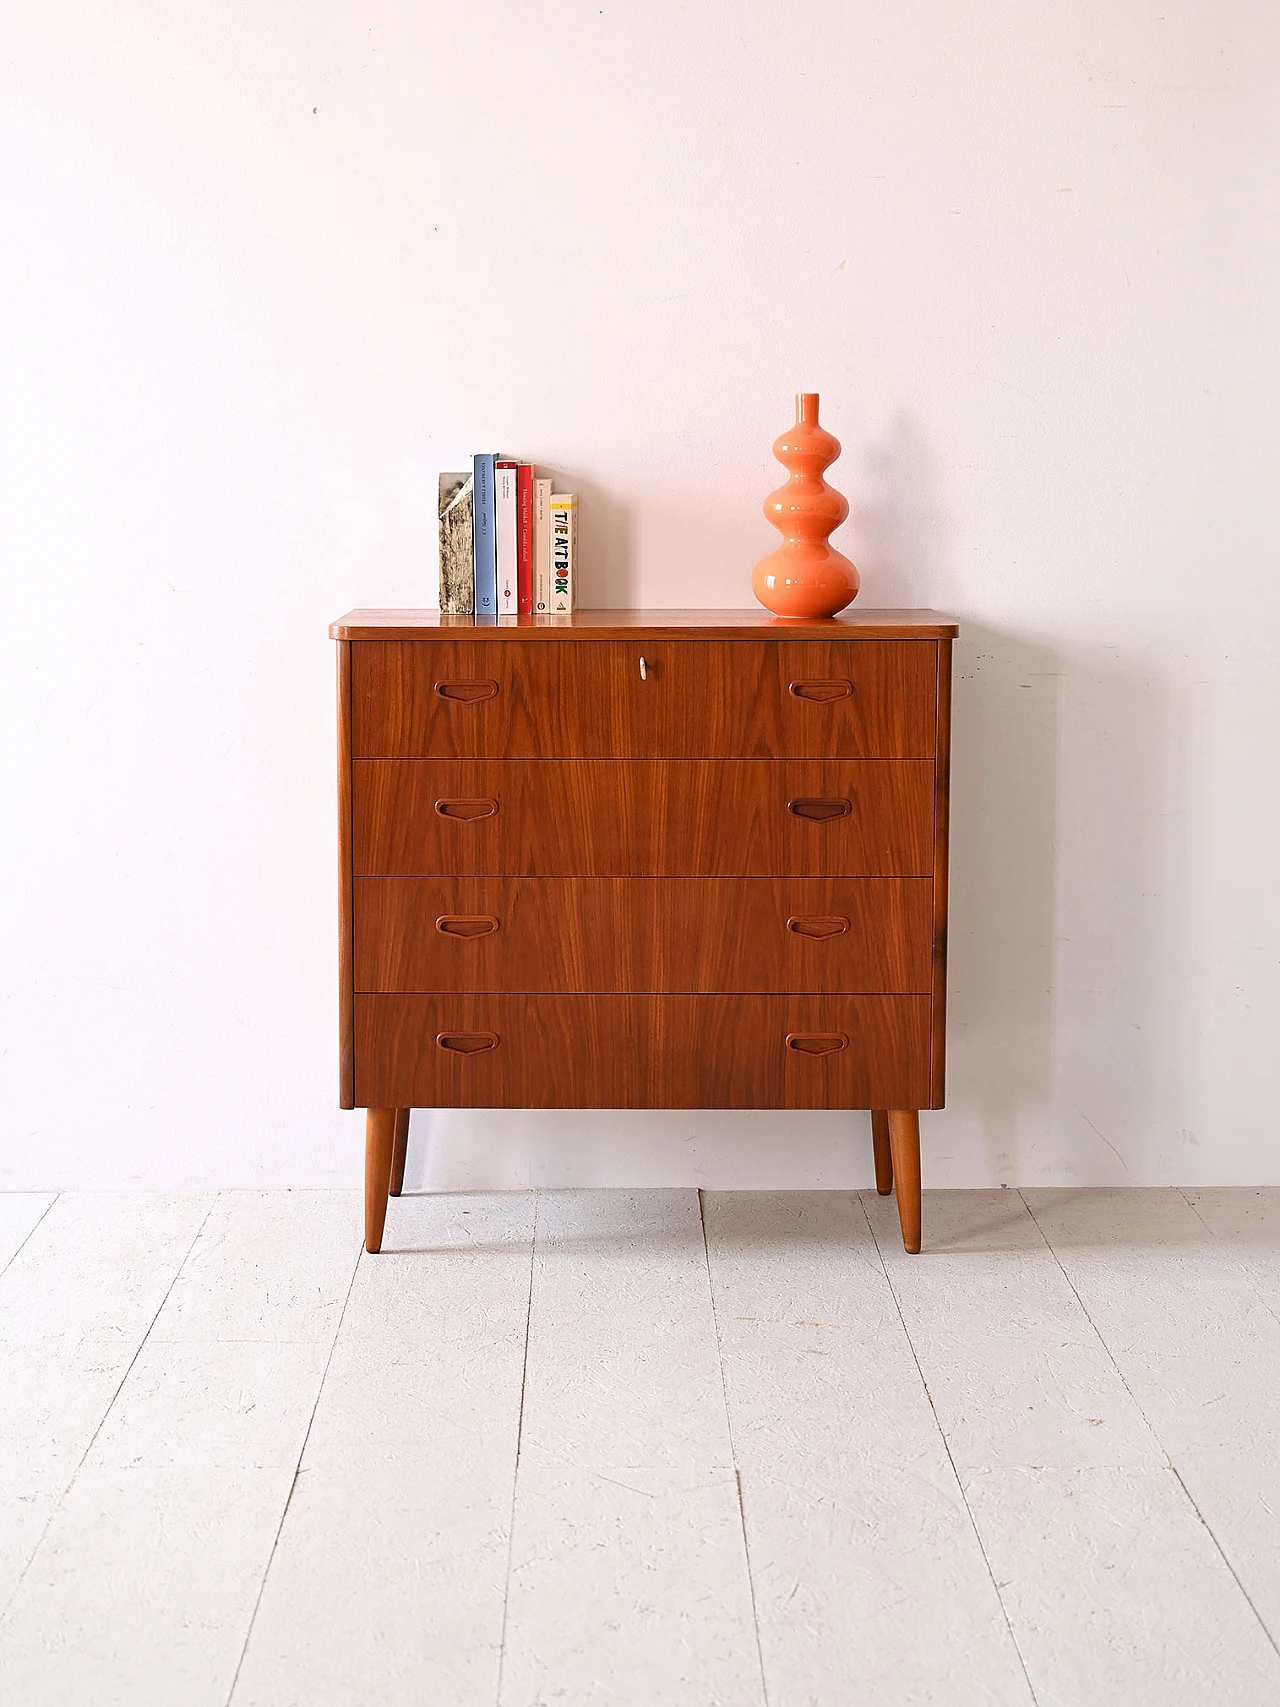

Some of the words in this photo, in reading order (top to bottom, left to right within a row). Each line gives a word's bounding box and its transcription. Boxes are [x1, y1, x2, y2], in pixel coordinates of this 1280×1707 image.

[554, 511, 568, 535] THE
[554, 537, 568, 560] ART
[554, 561, 568, 595] BOOK
